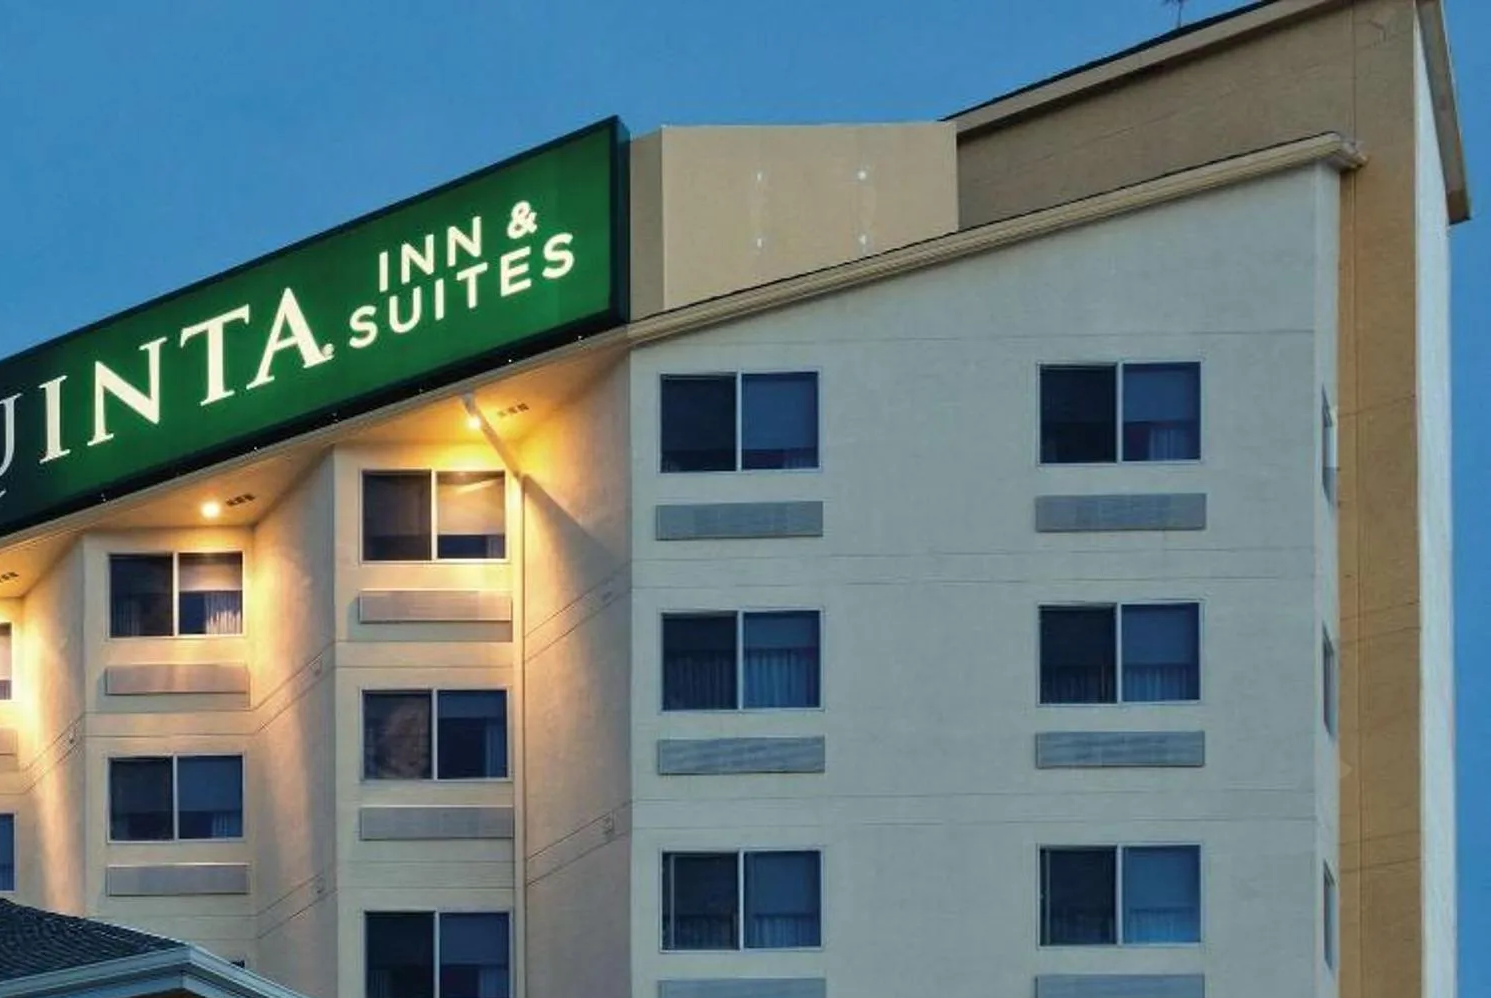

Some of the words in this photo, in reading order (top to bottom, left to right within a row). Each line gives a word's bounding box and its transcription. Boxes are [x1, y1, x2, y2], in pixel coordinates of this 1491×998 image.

[349, 232, 575, 349] SUITES
[378, 215, 482, 293] INN
[506, 200, 538, 240] &
